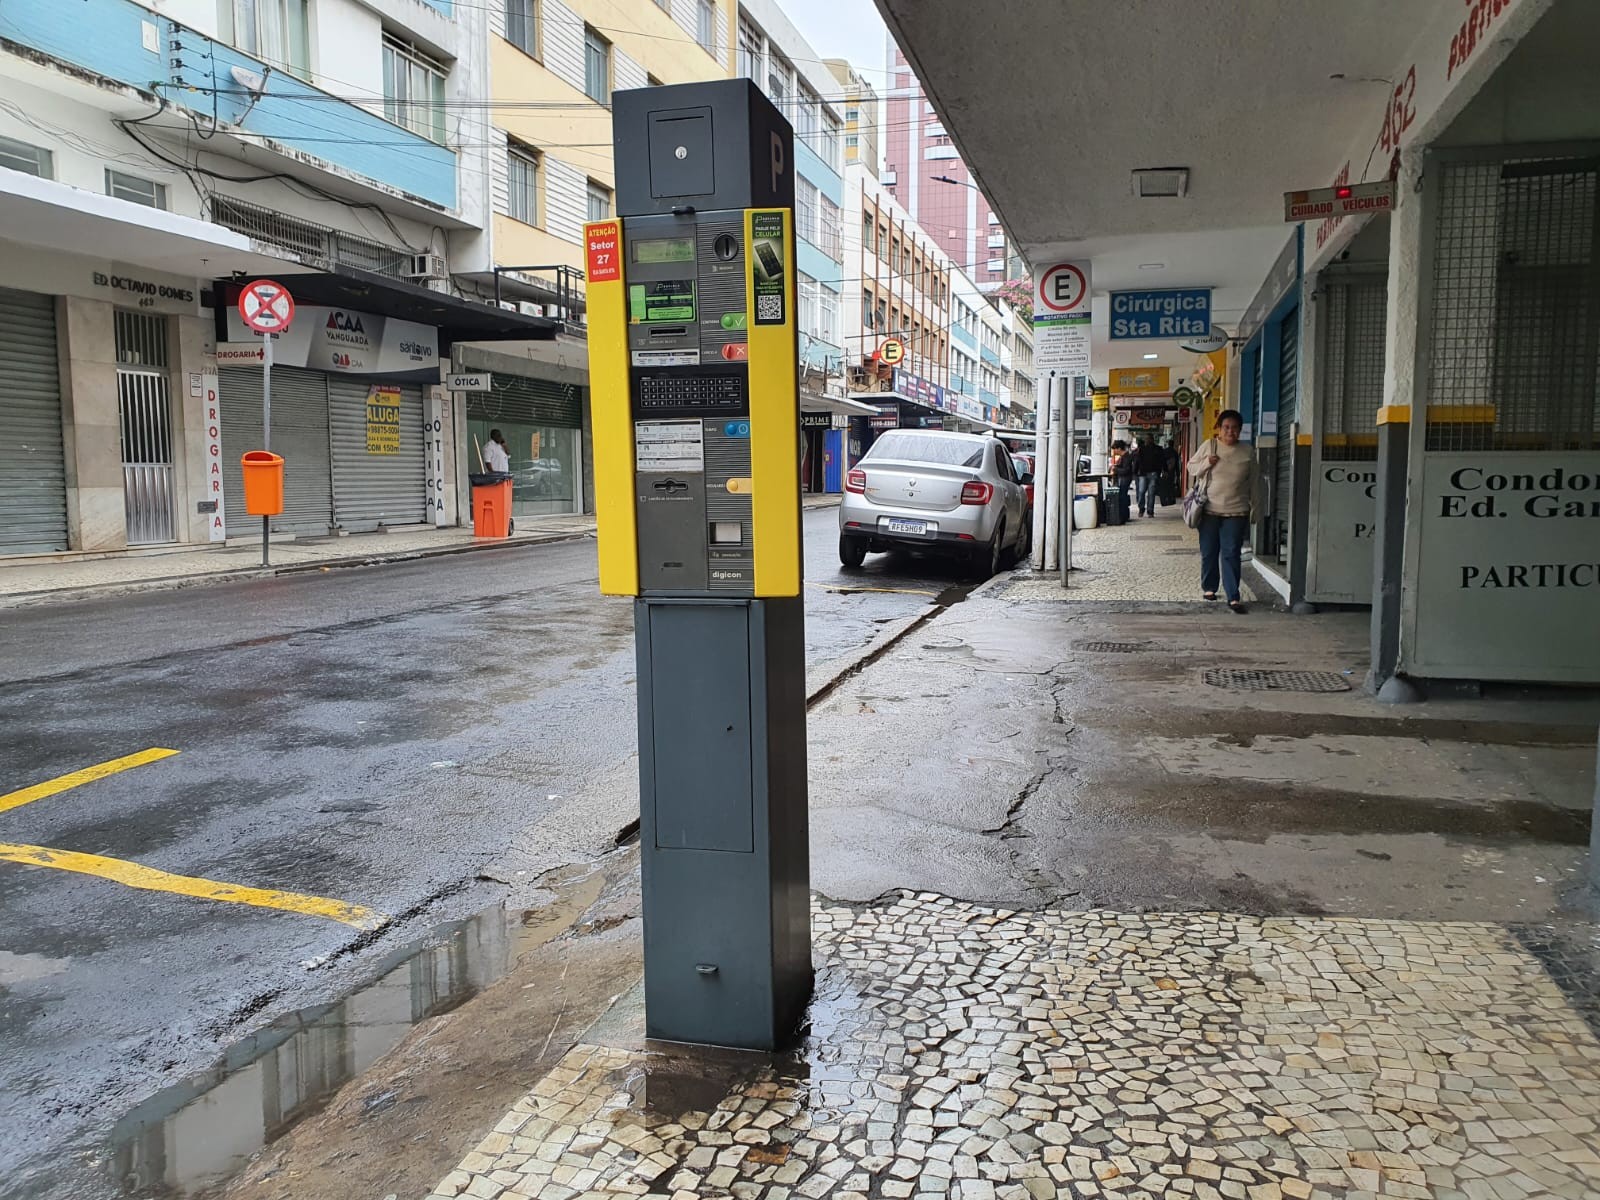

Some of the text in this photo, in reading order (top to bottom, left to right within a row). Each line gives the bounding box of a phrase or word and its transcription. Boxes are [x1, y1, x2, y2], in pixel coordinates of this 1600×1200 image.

[770, 131, 784, 193] P
[1291, 202, 1333, 217] CUIDADO
[590, 241, 615, 251] Setor
[596, 254, 610, 265] 27
[158, 285, 194, 303] GOMES
[1055, 274, 1070, 300] E
[1113, 293, 1207, 316] Cirúrgica
[1113, 317, 1205, 336] Sta Rita
[326, 331, 369, 345] VANGUARDA
[217, 350, 256, 359] DROGARIA
[886, 343, 898, 360] E
[454, 377, 481, 387] ÓTICA
[368, 406, 400, 423] ALUGA
[805, 416, 830, 424] PRIME
[207, 389, 223, 528] DROGARIA
[433, 415, 444, 511] ÓTICA
[1450, 467, 1600, 491] Condo
[1439, 495, 1508, 518] Ed.
[712, 570, 742, 579] digicon
[1460, 563, 1600, 589] PARTIC
